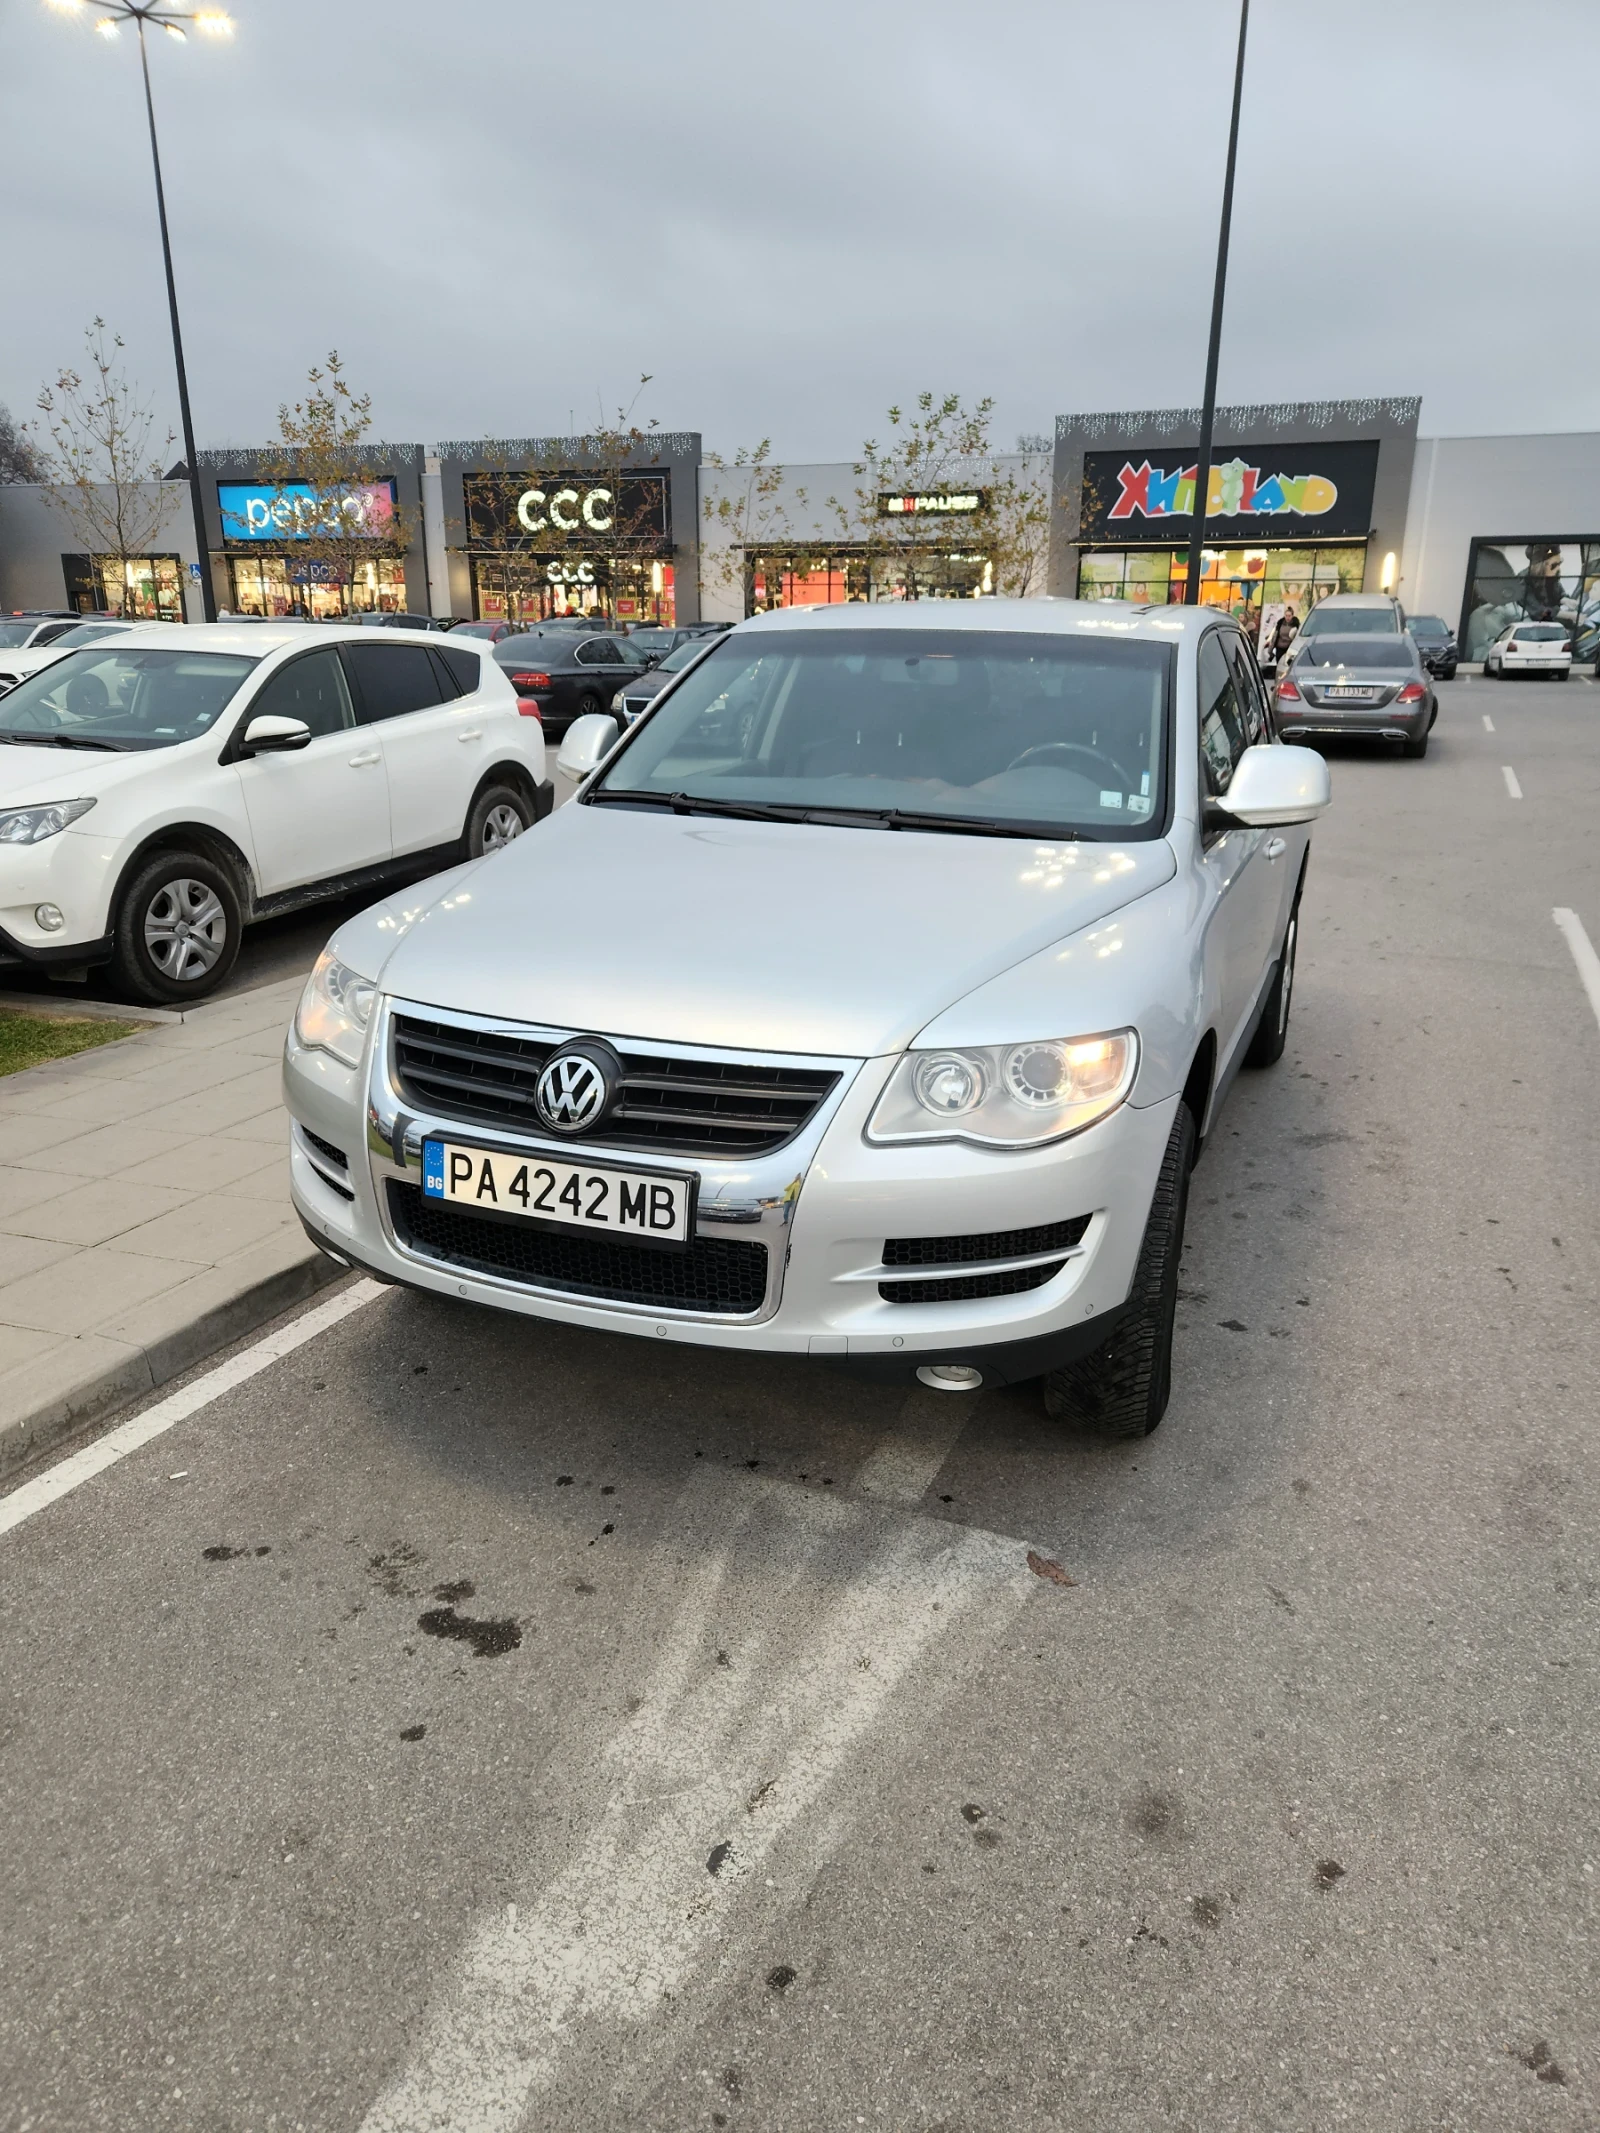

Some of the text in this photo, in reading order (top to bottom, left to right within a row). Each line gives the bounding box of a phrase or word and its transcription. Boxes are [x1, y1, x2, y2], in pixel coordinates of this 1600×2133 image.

[246, 496, 364, 535] pepco
[517, 488, 613, 531] CCC
[547, 561, 595, 583] CCC
[427, 1175, 443, 1190] BG
[450, 1152, 676, 1230] PA 4242 MB
